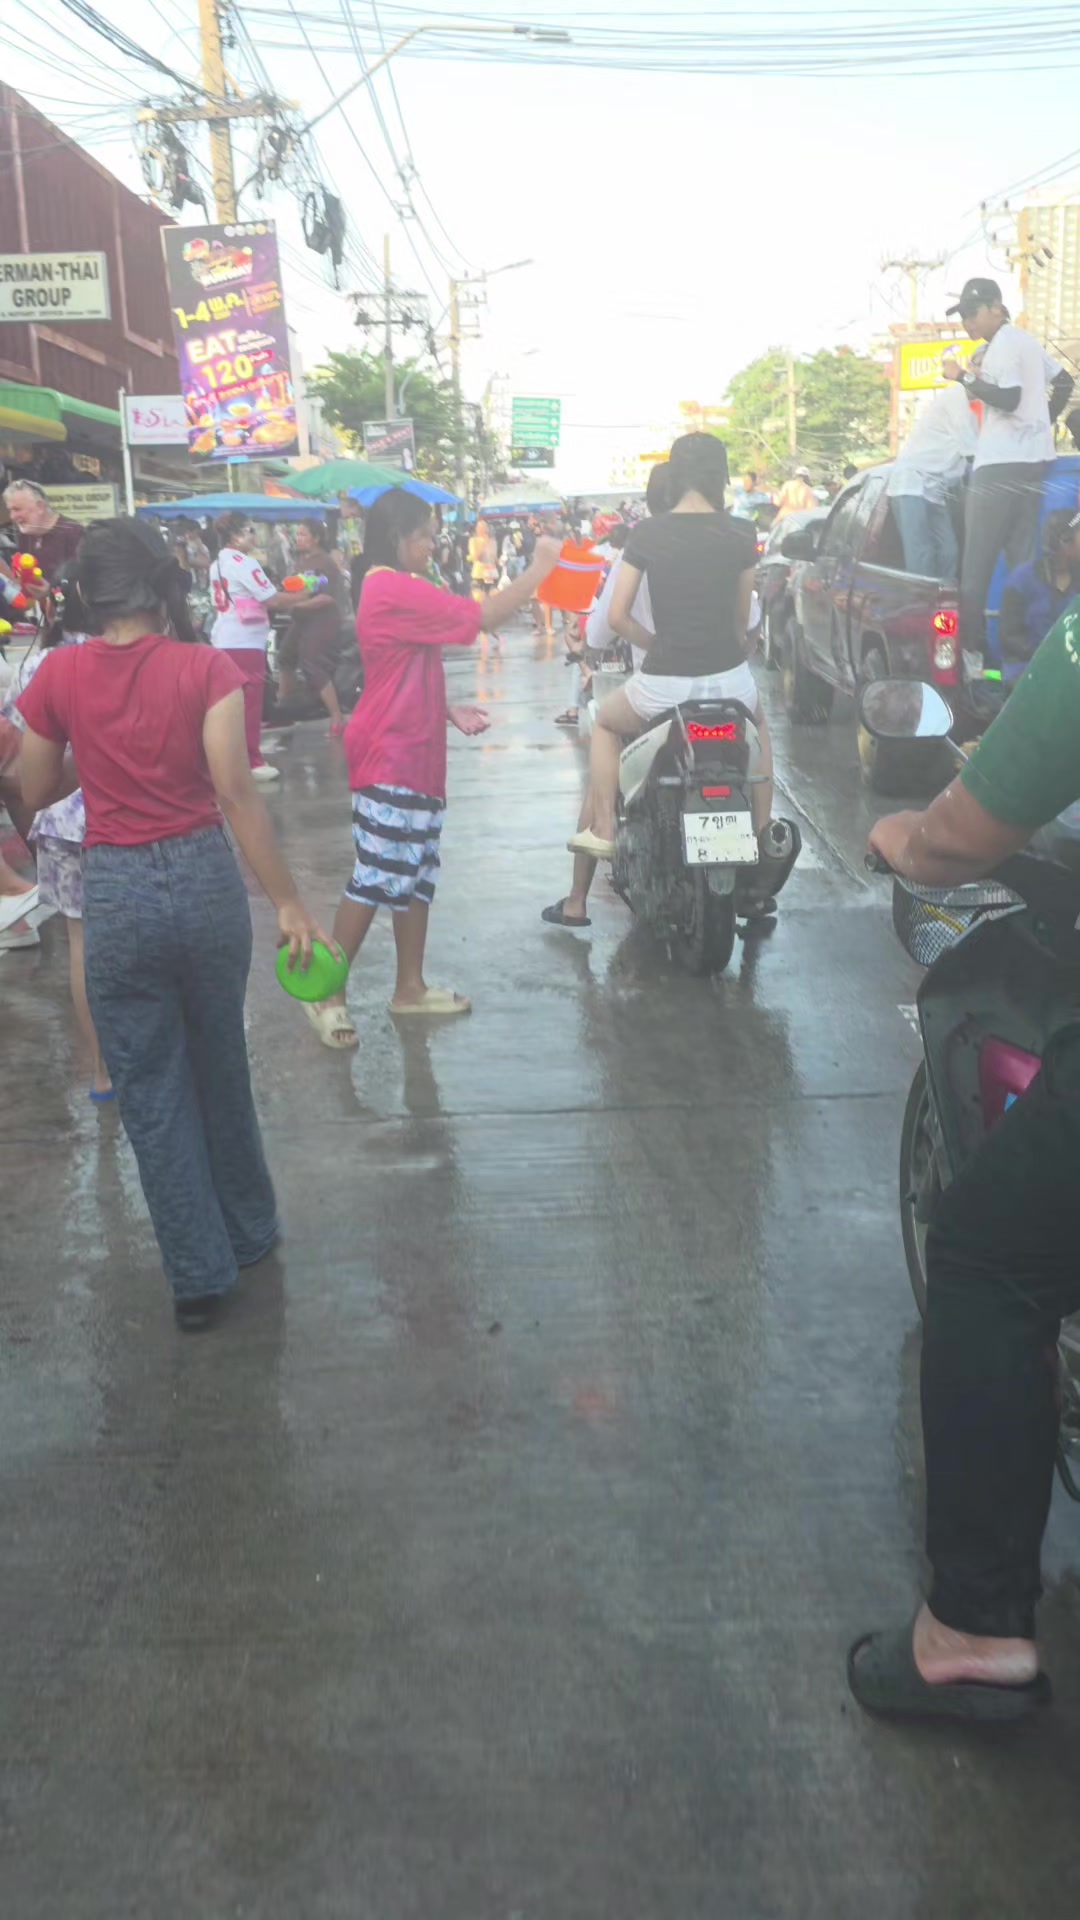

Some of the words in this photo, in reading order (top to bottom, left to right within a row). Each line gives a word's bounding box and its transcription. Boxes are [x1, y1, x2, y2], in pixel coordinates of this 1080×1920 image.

[12, 288, 71, 307] GROUP
[187, 330, 237, 365] EAT
[202, 354, 253, 388] 120
